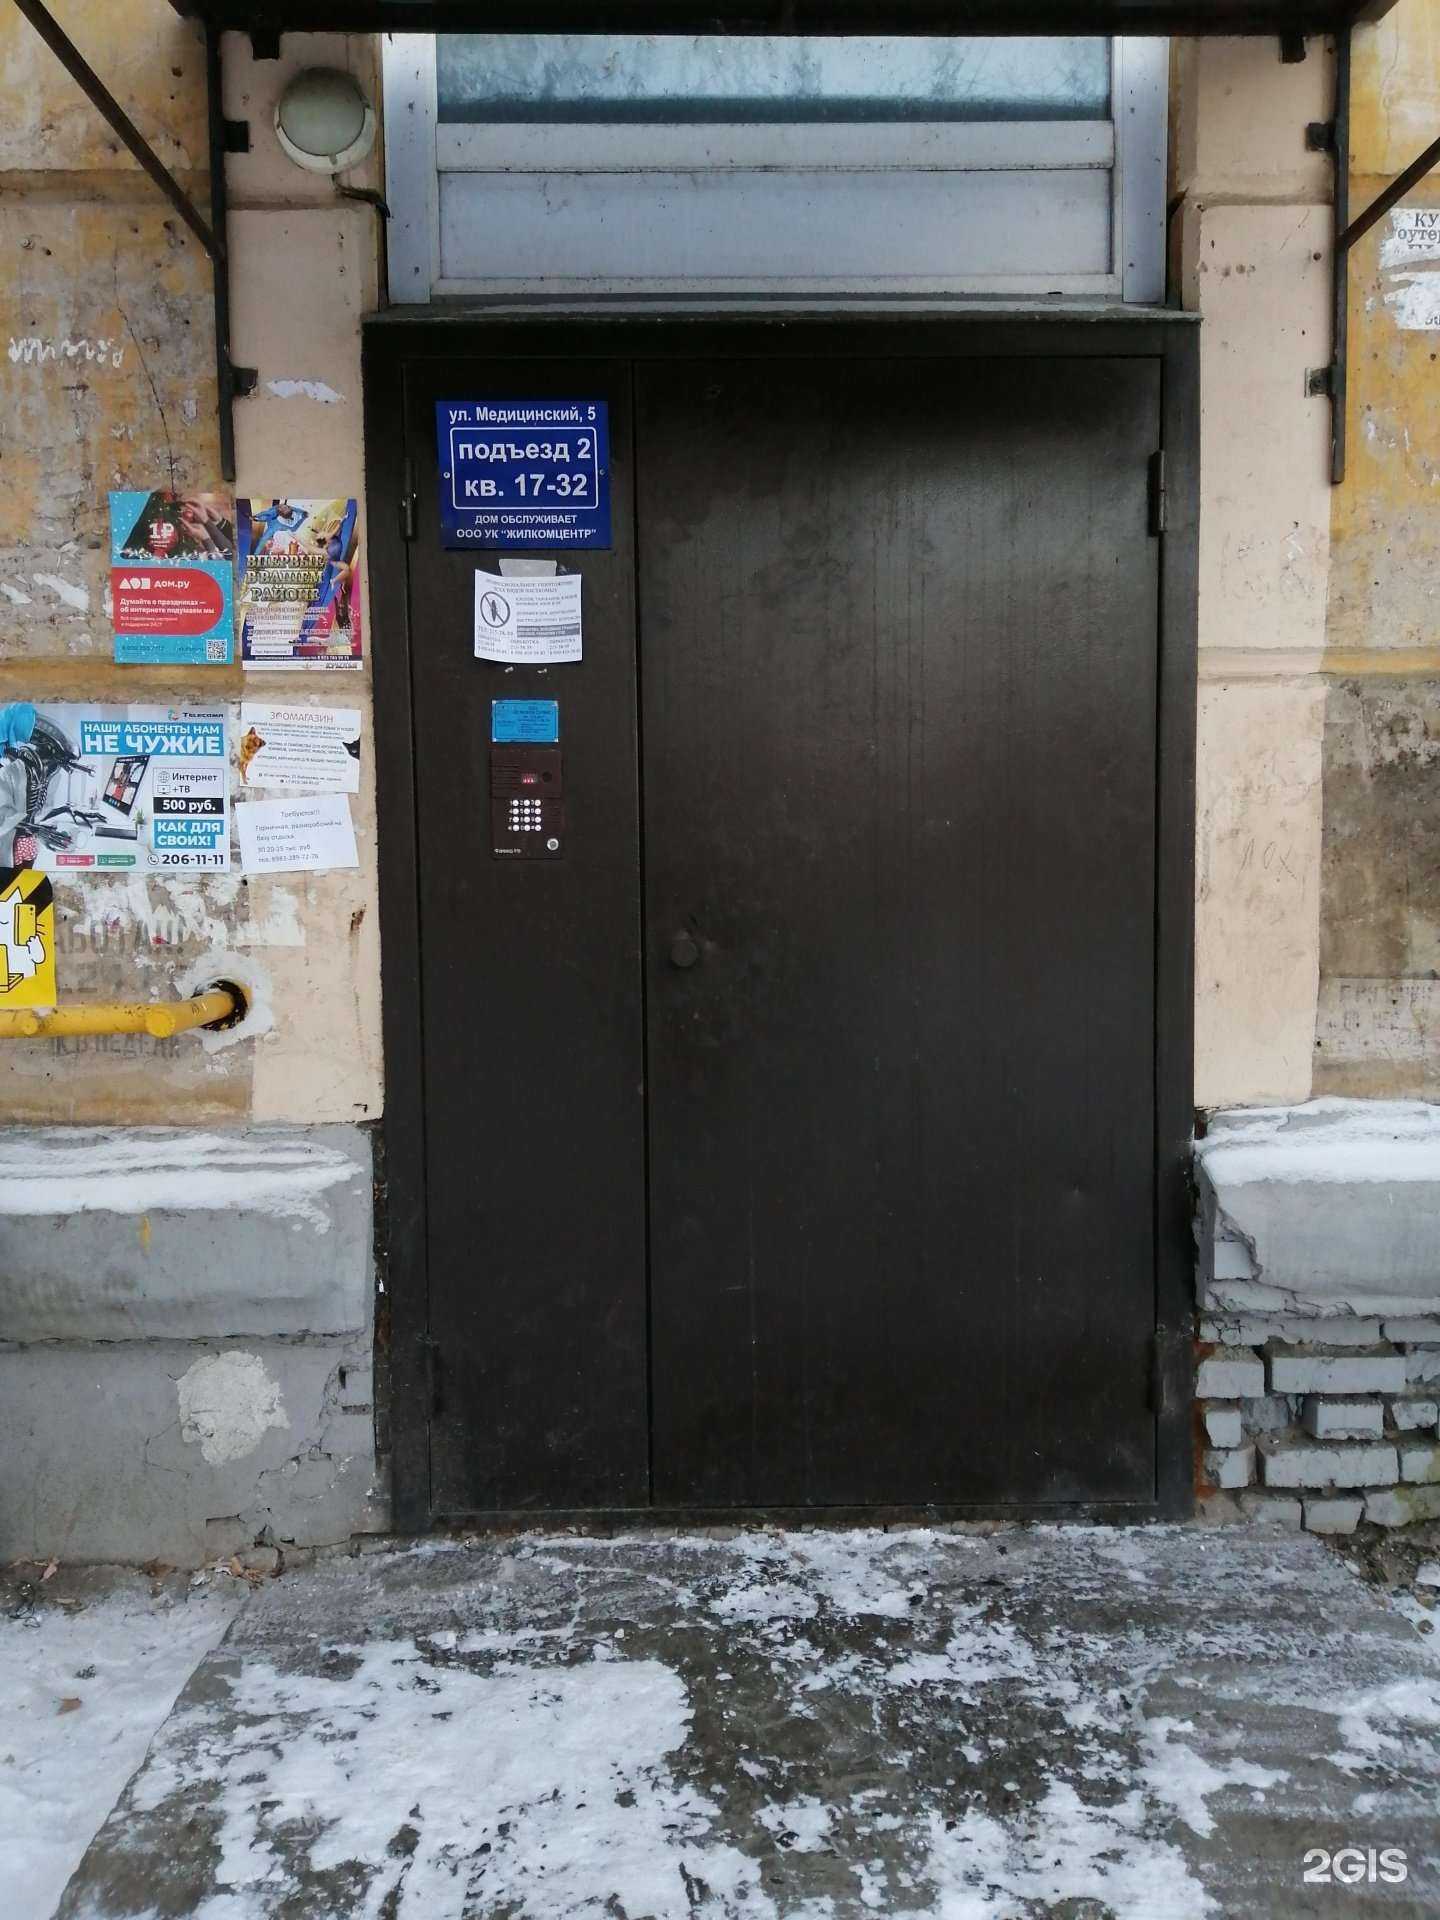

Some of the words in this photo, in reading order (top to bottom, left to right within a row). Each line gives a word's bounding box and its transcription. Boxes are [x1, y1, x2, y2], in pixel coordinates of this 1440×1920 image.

[449, 409, 472, 424] ул.
[476, 406, 583, 423] Медицинский,
[587, 406, 596, 421] 5
[458, 442, 570, 463] подъезд
[577, 438, 591, 460] 2
[465, 478, 504, 497] кв.
[514, 473, 588, 497] 17-32
[475, 515, 498, 525] ДОМ
[500, 514, 577, 525] ОБСЛУЖИВАЕТ
[456, 529, 482, 538] ООО
[485, 529, 498, 538] УК
[246, 553, 325, 569] ВПЕРВЫЕ
[246, 569, 256, 584] В
[258, 569, 325, 585] ВАШЕМ
[251, 584, 320, 602] РАЙОНЕ
[84, 723, 120, 733] НАШИ
[124, 723, 190, 734] АБОНЕНТЫ
[193, 725, 220, 735] НАМ
[85, 735, 120, 753] НЕ
[126, 735, 221, 754] ЧУЖИЕ
[172, 773, 218, 783] Интернет
[172, 784, 190, 794] +ТВ
[162, 799, 186, 811] 500
[188, 799, 216, 814] руб.
[157, 821, 187, 833] КАК
[190, 822, 221, 835] ДЛЯ
[157, 835, 212, 846] СВОИХ!
[161, 854, 224, 865] 206-11-11
